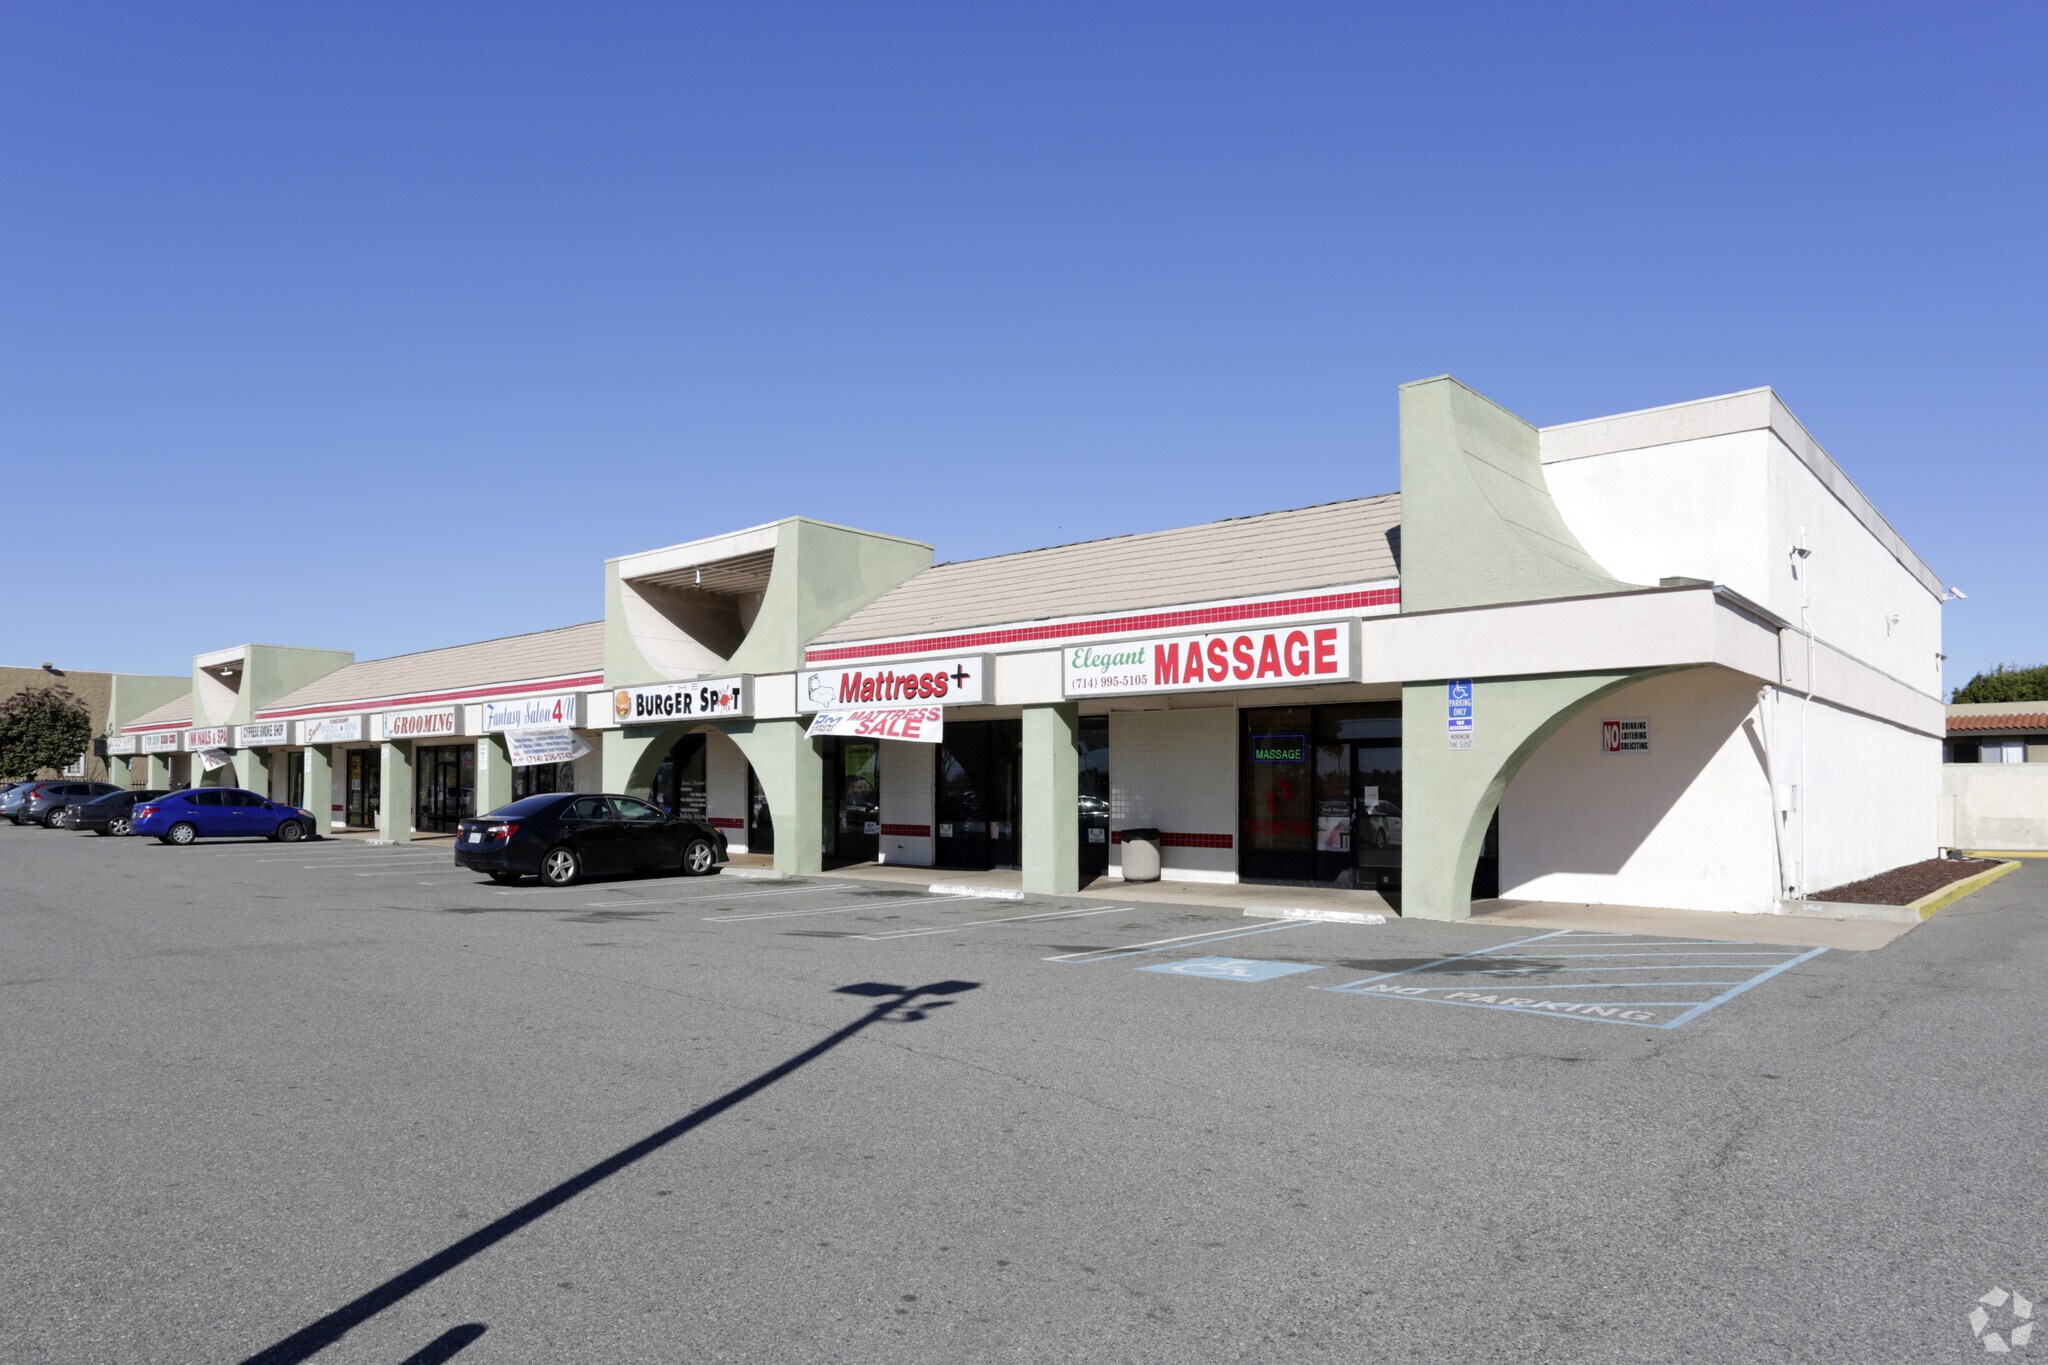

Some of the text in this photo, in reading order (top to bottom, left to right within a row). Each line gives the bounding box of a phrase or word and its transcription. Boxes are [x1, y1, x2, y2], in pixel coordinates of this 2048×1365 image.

[1071, 646, 1146, 674] Elegant
[1154, 627, 1338, 686] MASSAGE
[667, 682, 698, 692] THE
[1071, 674, 1148, 690] (714) 995-5105
[636, 692, 692, 716] BURGER
[1449, 698, 1472, 707] PARKING
[487, 703, 521, 730] Fantasy
[524, 701, 551, 725] Salon
[552, 699, 563, 723] 4
[847, 707, 940, 722] MATTRESS
[1453, 707, 1467, 716] ONLY
[243, 723, 284, 738] CYPRESS SMOKE SHOP
[393, 712, 454, 734] GROOMING
[854, 718, 923, 739] SALE
[1621, 721, 1647, 730] DRINKING
[197, 730, 211, 746] NAILS
[217, 728, 227, 745] SPA
[1603, 724, 1620, 749] NO
[1621, 731, 1647, 740] LOITERING
[1620, 741, 1648, 750] SOLICITING
[526, 754, 544, 764] (714)
[1255, 749, 1302, 760] MASSAGE
[1363, 984, 1656, 1021] NO PARKING
